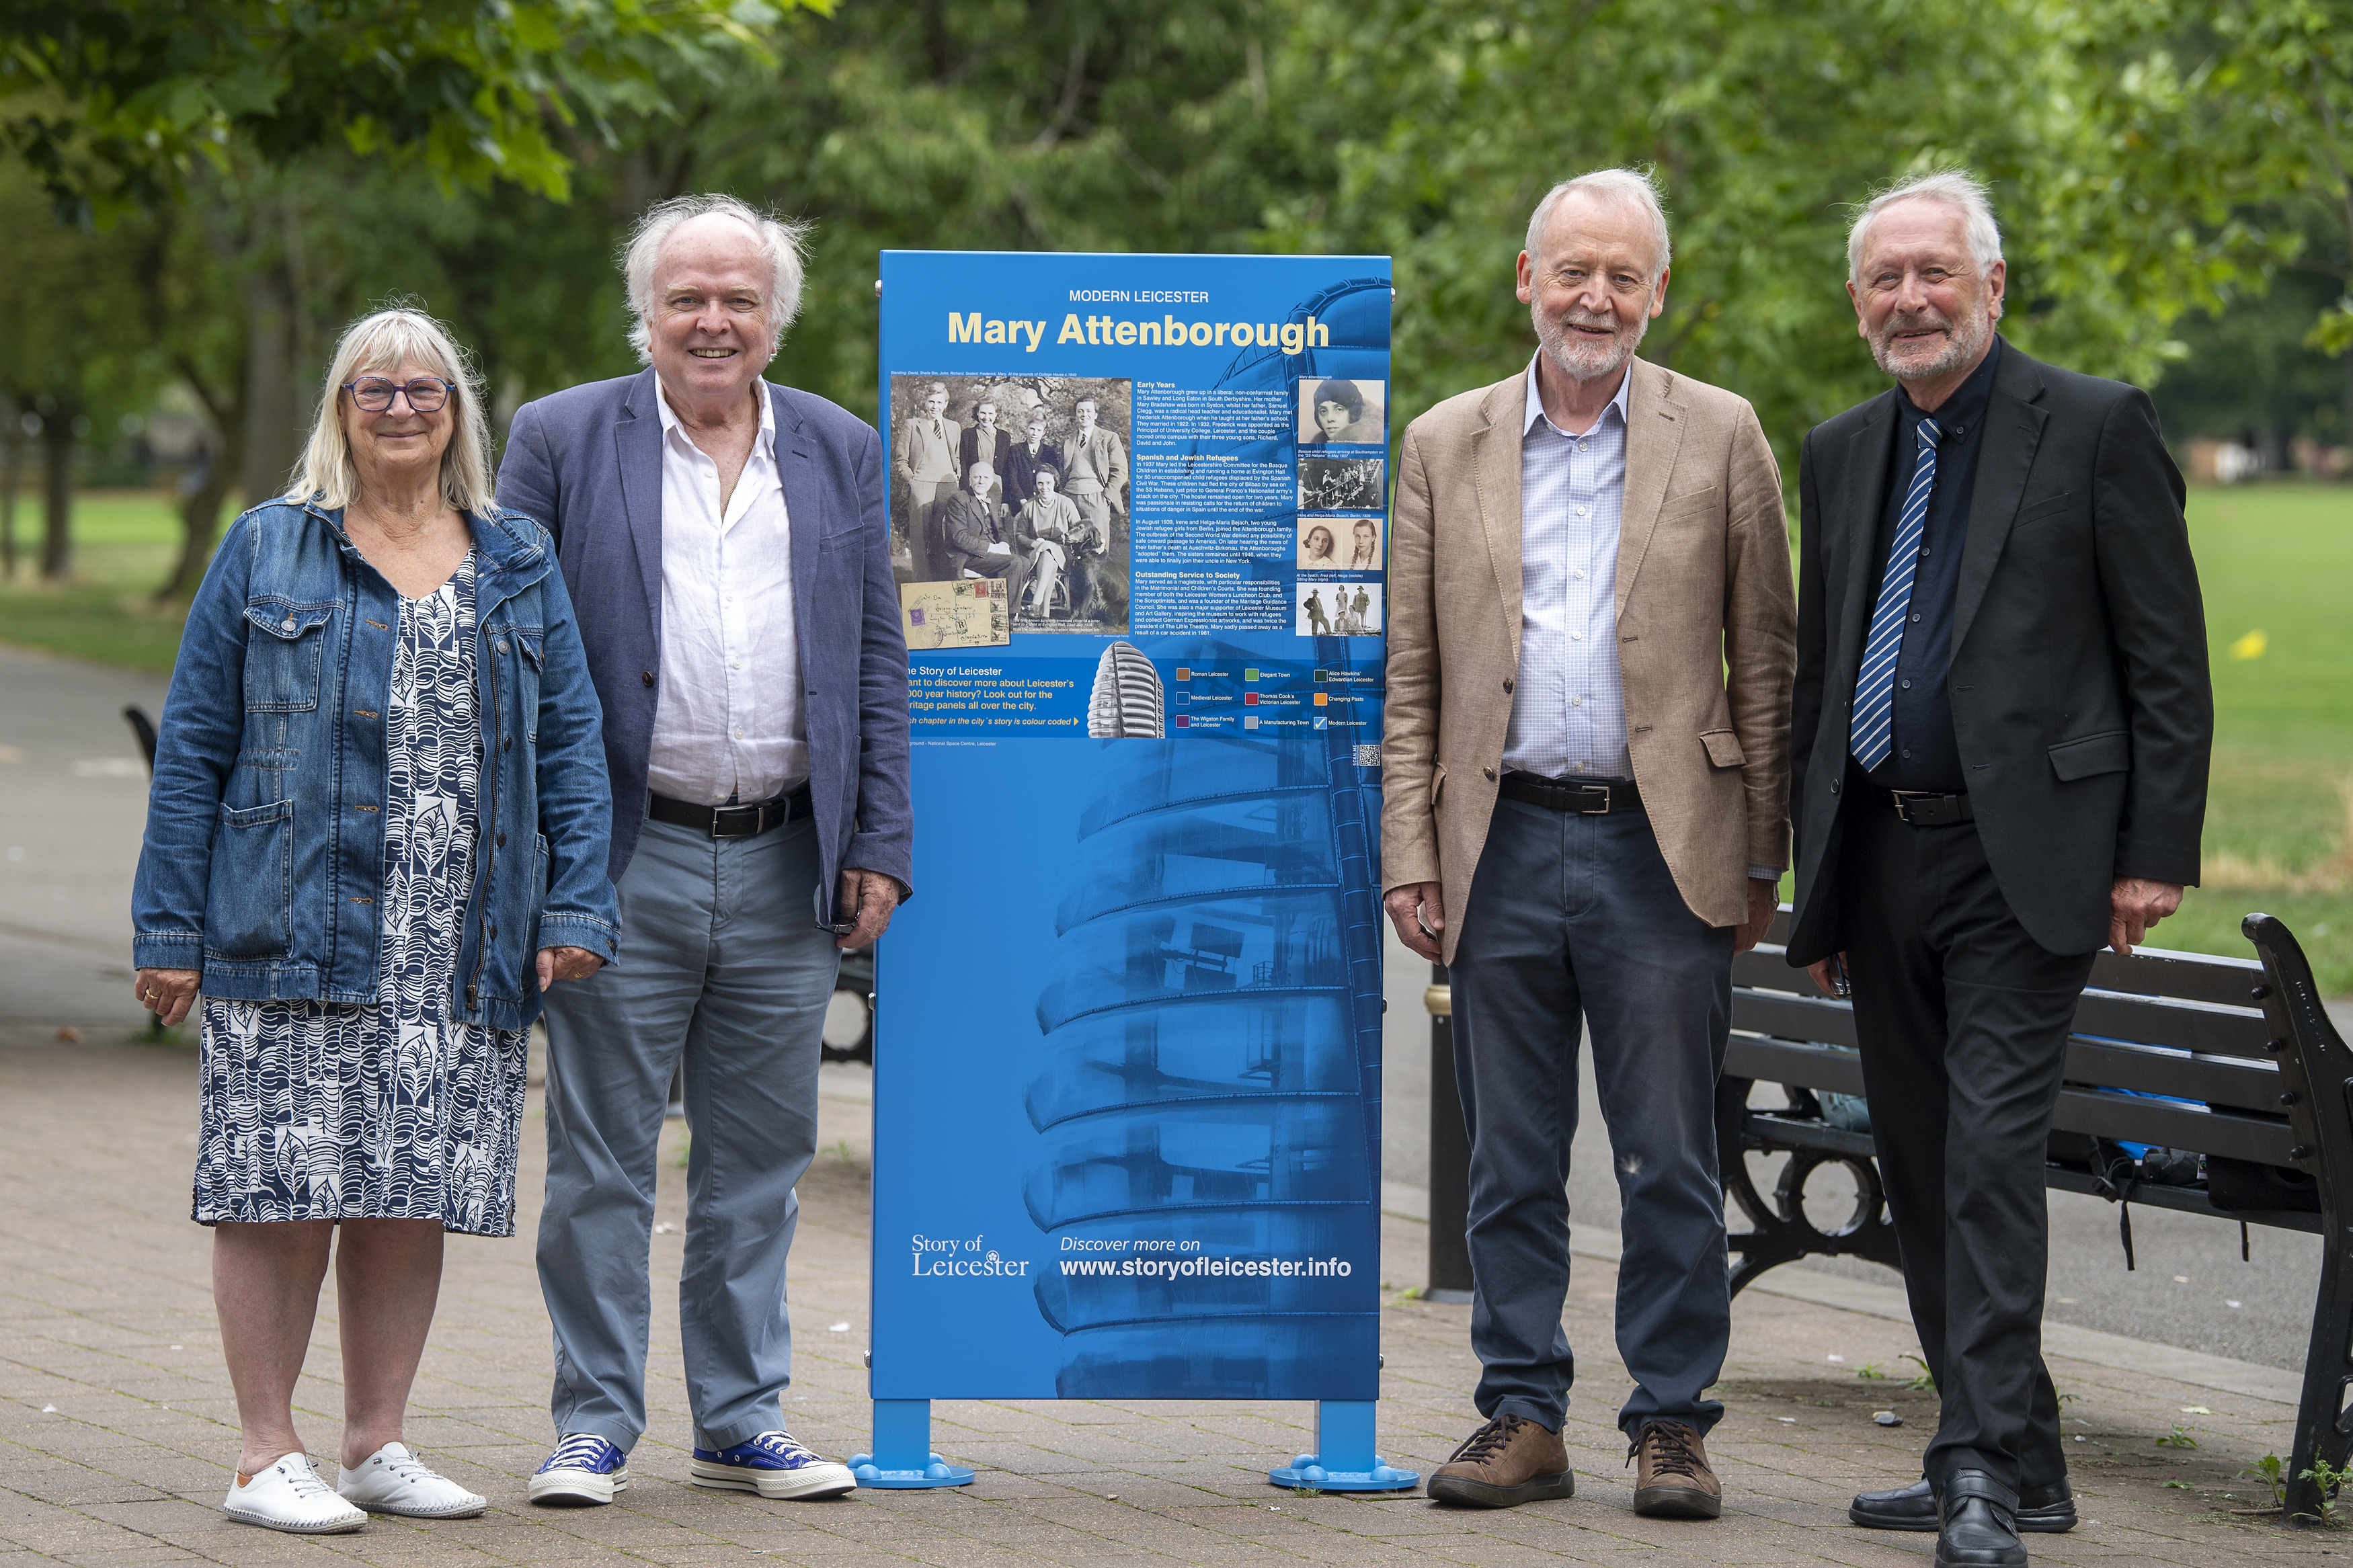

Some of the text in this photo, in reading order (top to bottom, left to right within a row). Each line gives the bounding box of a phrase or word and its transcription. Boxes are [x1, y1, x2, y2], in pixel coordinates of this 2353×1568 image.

[1069, 290, 1209, 303] MODERN LEICESTER
[947, 312, 1330, 356] Mary Attenborough
[920, 667, 945, 677] Story
[947, 667, 957, 675] of
[959, 667, 1002, 675] Leicester
[934, 679, 972, 687] discover
[947, 690, 982, 700] history?
[984, 690, 1006, 698] Look
[910, 701, 934, 710] ritage
[936, 701, 966, 710] panels
[1002, 702, 1016, 710] the
[1019, 702, 1036, 711] city.
[919, 718, 947, 726] chapter
[994, 718, 1012, 726] story
[912, 1234, 983, 1256] Story of
[1060, 1236, 1200, 1251] Discover more on
[912, 1253, 1029, 1277] Leicester
[1060, 1257, 1351, 1280] www.storyofleicester.info
